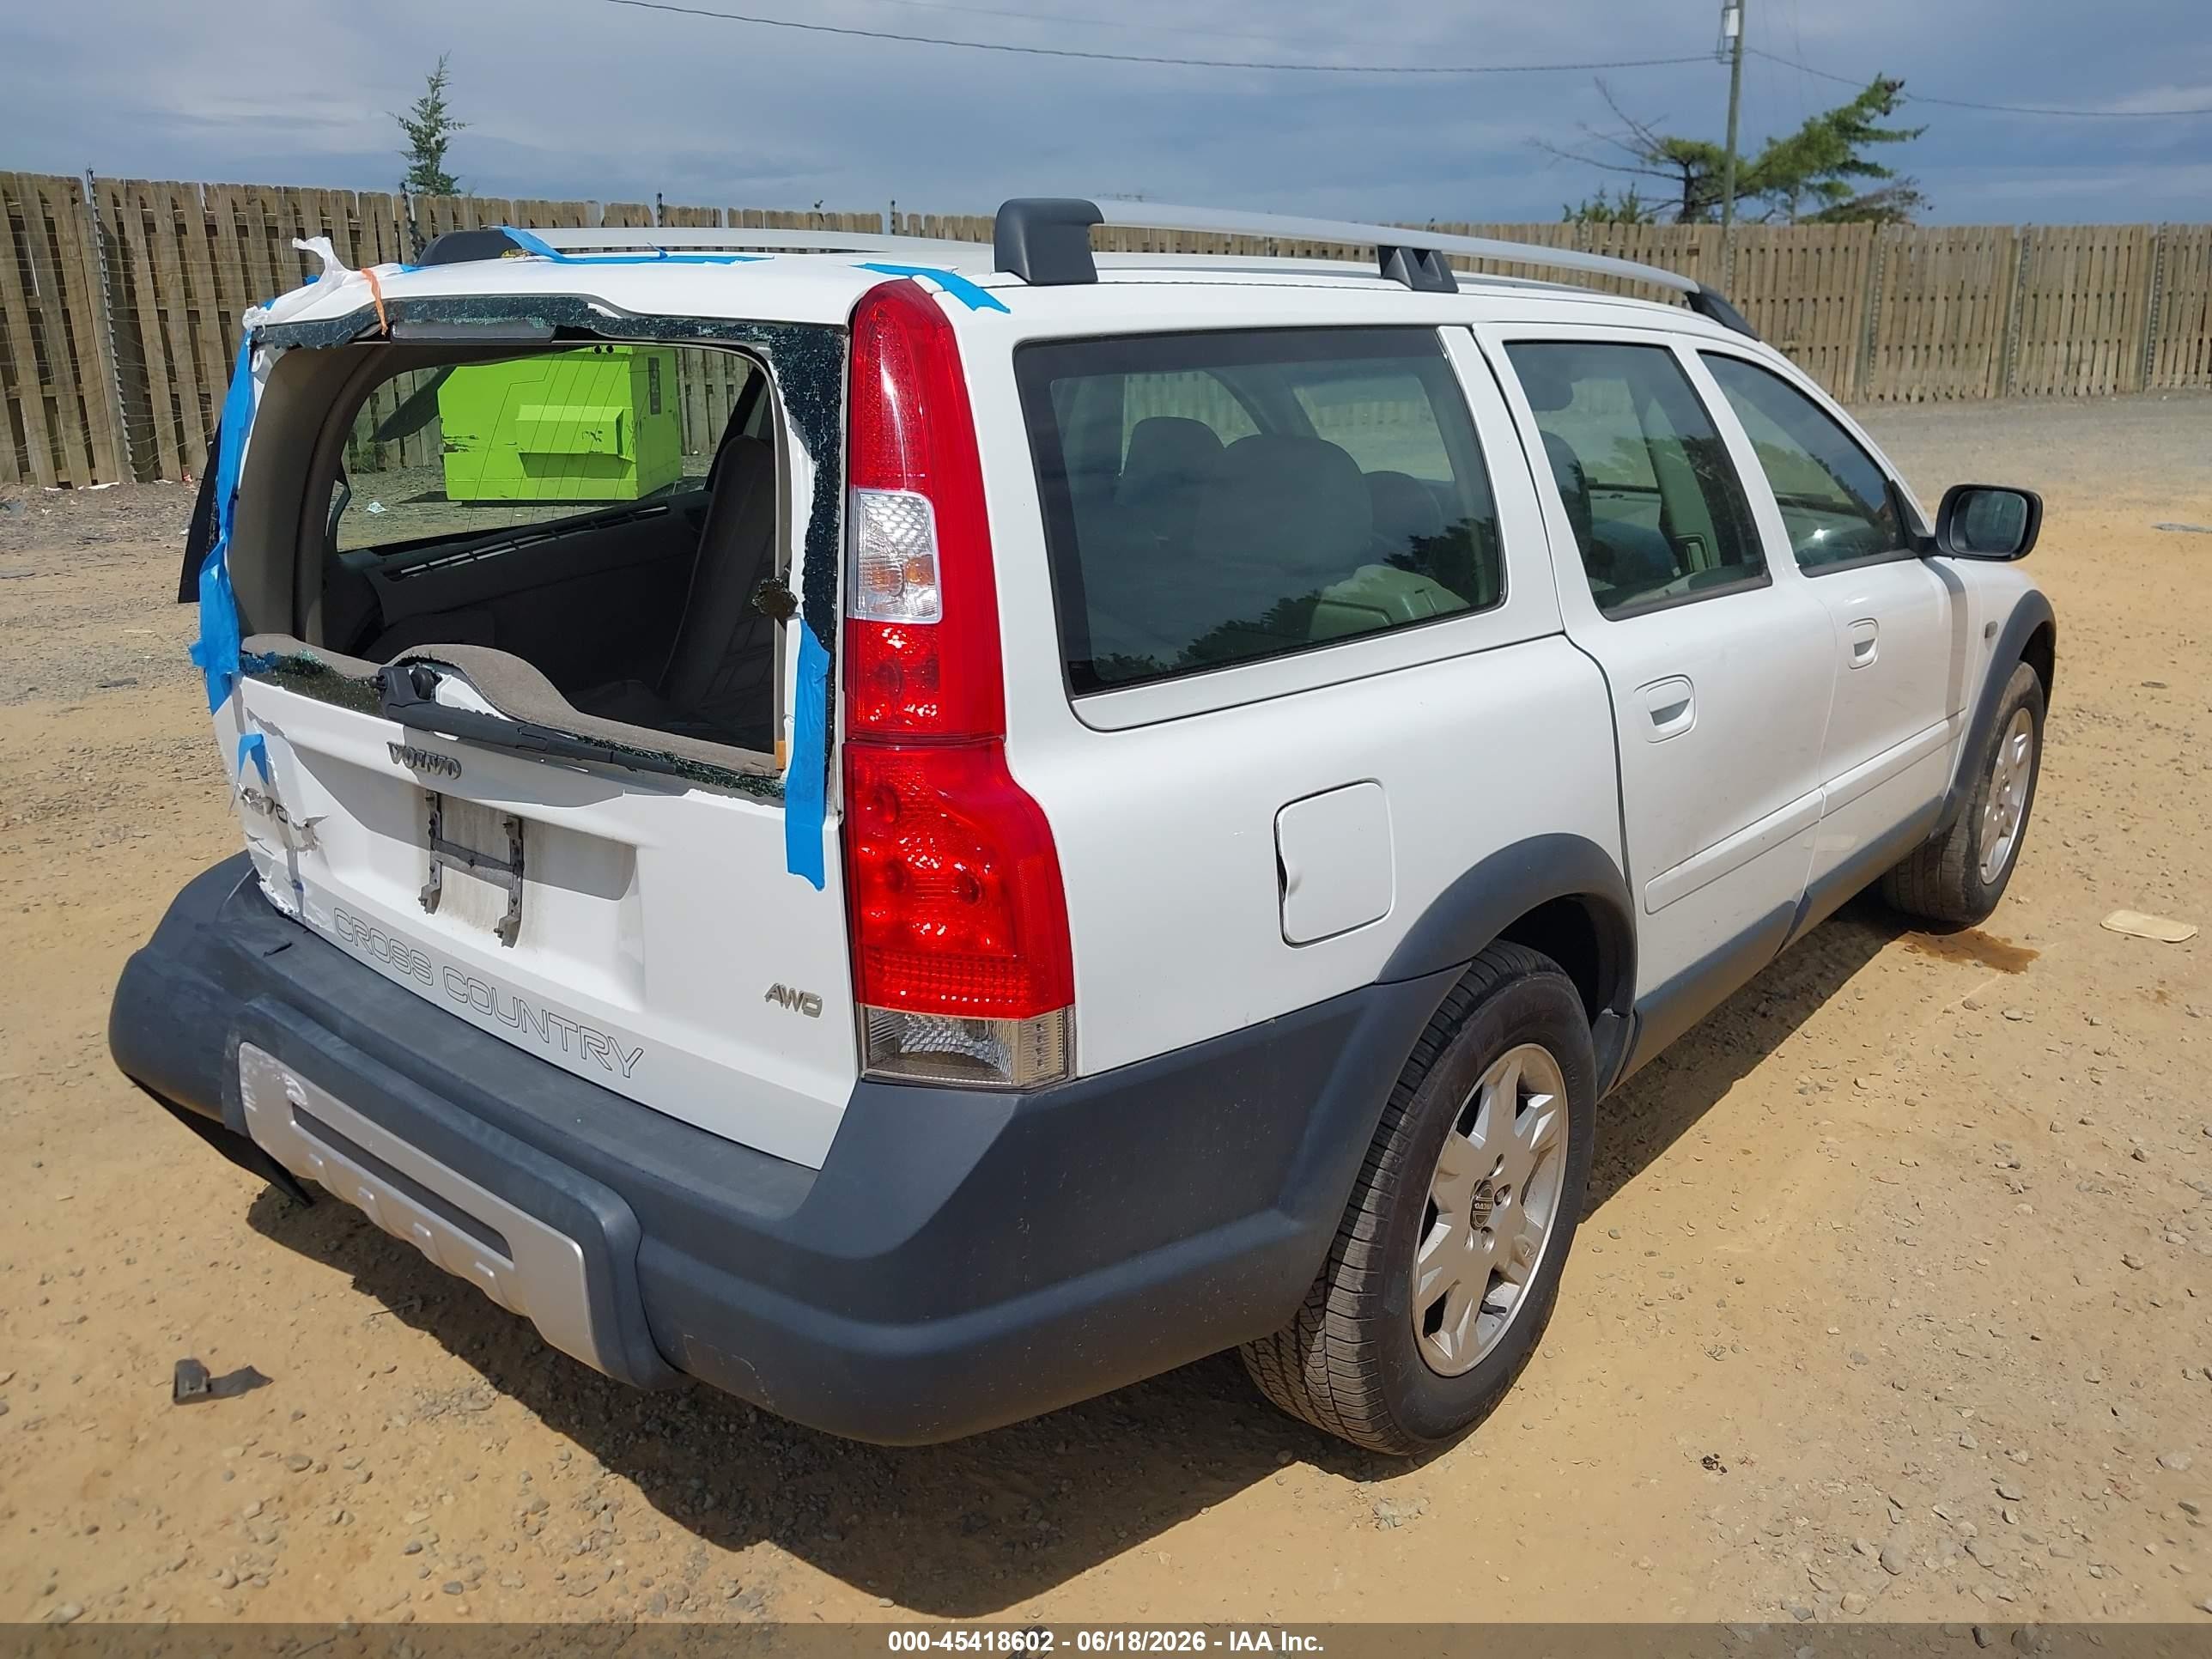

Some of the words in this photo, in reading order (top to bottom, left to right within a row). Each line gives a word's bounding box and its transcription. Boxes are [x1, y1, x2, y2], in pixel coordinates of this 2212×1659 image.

[386, 741, 462, 781] VOLVO
[334, 907, 434, 987] CROSS
[442, 965, 644, 1079] COUNTRY
[764, 982, 823, 1018] AWD
